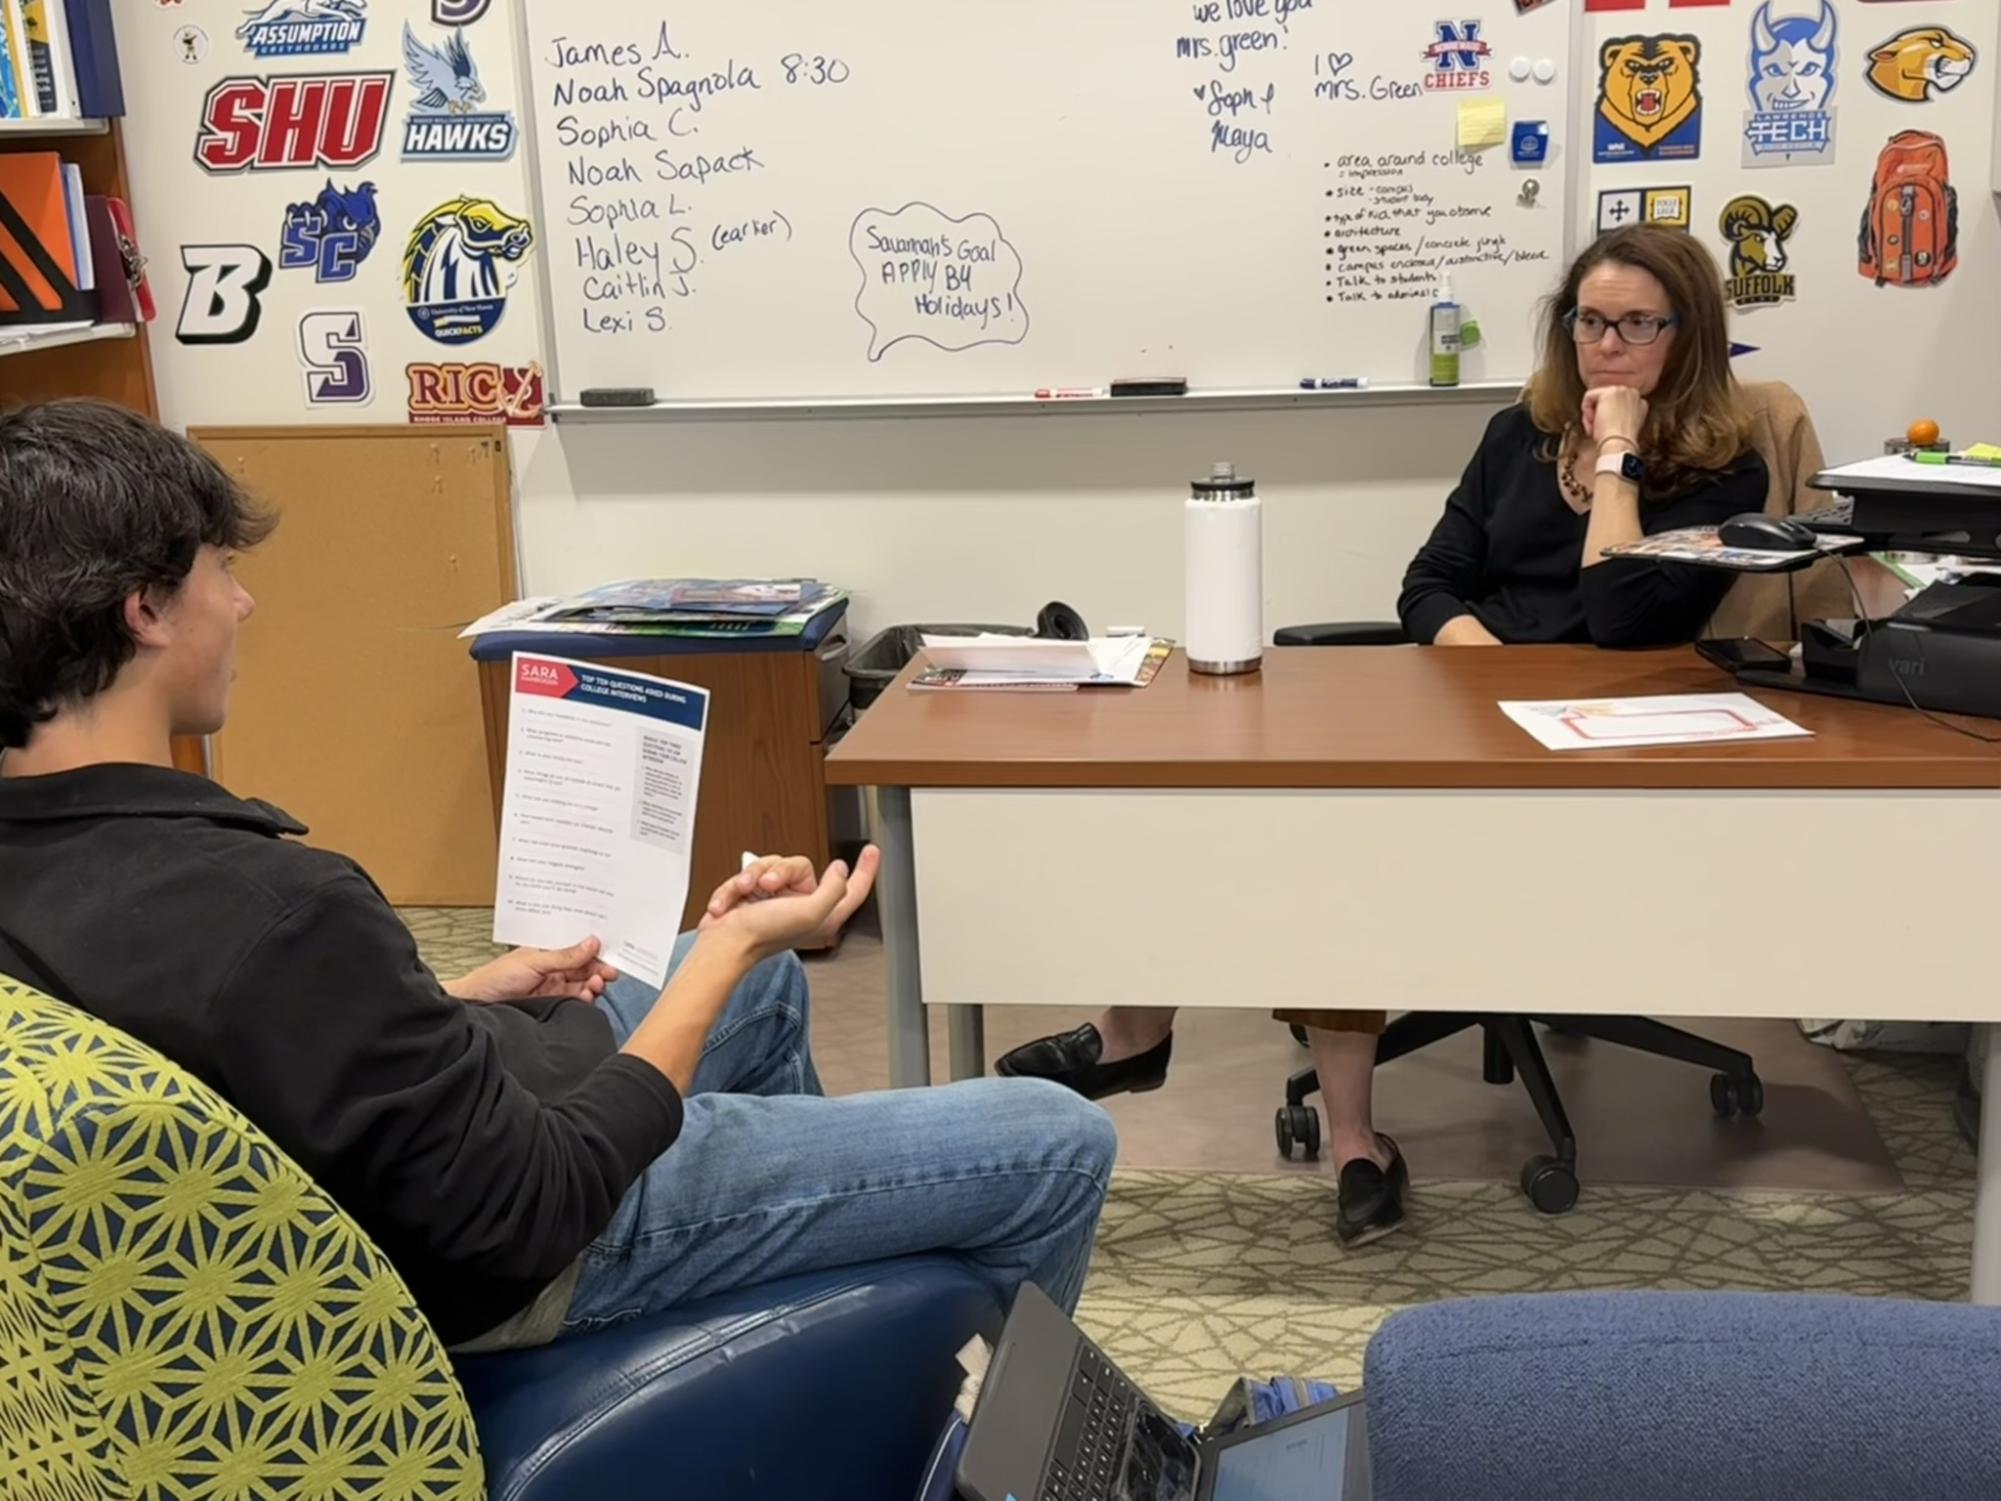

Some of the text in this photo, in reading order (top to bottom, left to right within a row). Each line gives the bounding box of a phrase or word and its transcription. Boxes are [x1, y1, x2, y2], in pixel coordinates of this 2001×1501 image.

[1193, 0, 1313, 25] we love you
[252, 20, 361, 45] ASSUMPTION
[545, 20, 690, 69] James A.
[1435, 20, 1481, 71] N
[1314, 54, 1319, 75] I
[554, 53, 850, 112] Noah Spagnola 8:30
[1369, 75, 1424, 101] Green
[1425, 70, 1490, 88] CHIEFS
[197, 75, 392, 168] SHU
[556, 107, 699, 148] Sophia C.
[1748, 119, 1827, 142] TECH
[406, 123, 509, 151] HAWKS
[1211, 119, 1273, 164] Maya
[568, 155, 643, 186] Noah
[1337, 150, 1483, 175] area around college
[1337, 185, 1364, 197] size
[567, 194, 693, 230] Sophia L.
[1393, 206, 1422, 218] that
[1426, 208, 1448, 224] you
[866, 225, 996, 263] Savannah's Goal
[1334, 226, 1401, 238] architecture
[575, 232, 660, 281] Haley
[1338, 244, 1371, 260] green
[1338, 259, 1384, 274] campus
[583, 270, 697, 302] Caitlin J.
[1336, 271, 1437, 288] Talk to students
[1724, 274, 1795, 299] SUFFOLK
[176, 244, 272, 344] B
[1338, 290, 1367, 303] Talk
[1371, 291, 1382, 300] to
[583, 307, 633, 333] Lexi
[299, 312, 370, 402] S
[410, 365, 500, 409] RIC
[521, 664, 559, 681] SARA
[1888, 657, 1925, 676] vari
[581, 674, 595, 683] TOP
[596, 676, 609, 685] TEN
[609, 678, 645, 694] QUESTIONS
[581, 683, 610, 695] COLLEGE
